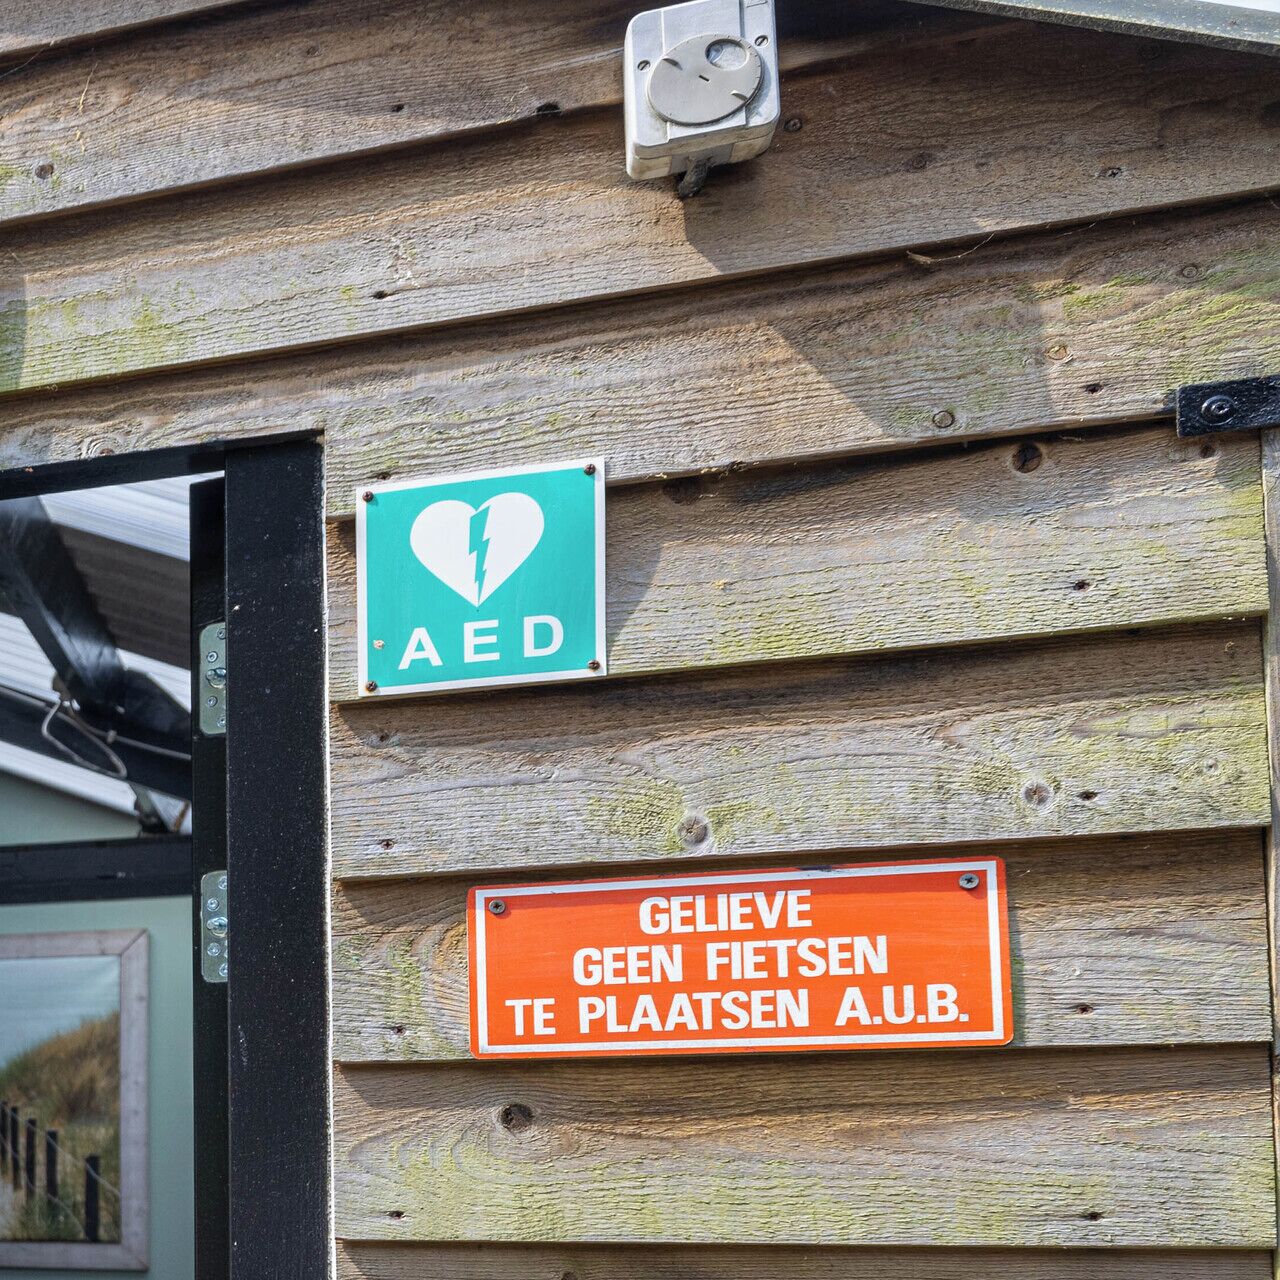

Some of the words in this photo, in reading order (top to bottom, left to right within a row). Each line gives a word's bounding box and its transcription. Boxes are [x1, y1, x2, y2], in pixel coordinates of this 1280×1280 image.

[398, 614, 564, 670] AED
[639, 889, 813, 935] GELIEVE
[572, 943, 683, 986] GEEN
[706, 935, 888, 982] FIETSEN
[505, 997, 556, 1036] TE
[578, 988, 809, 1034] PLAATSEN
[835, 983, 969, 1026] A.U.B.
